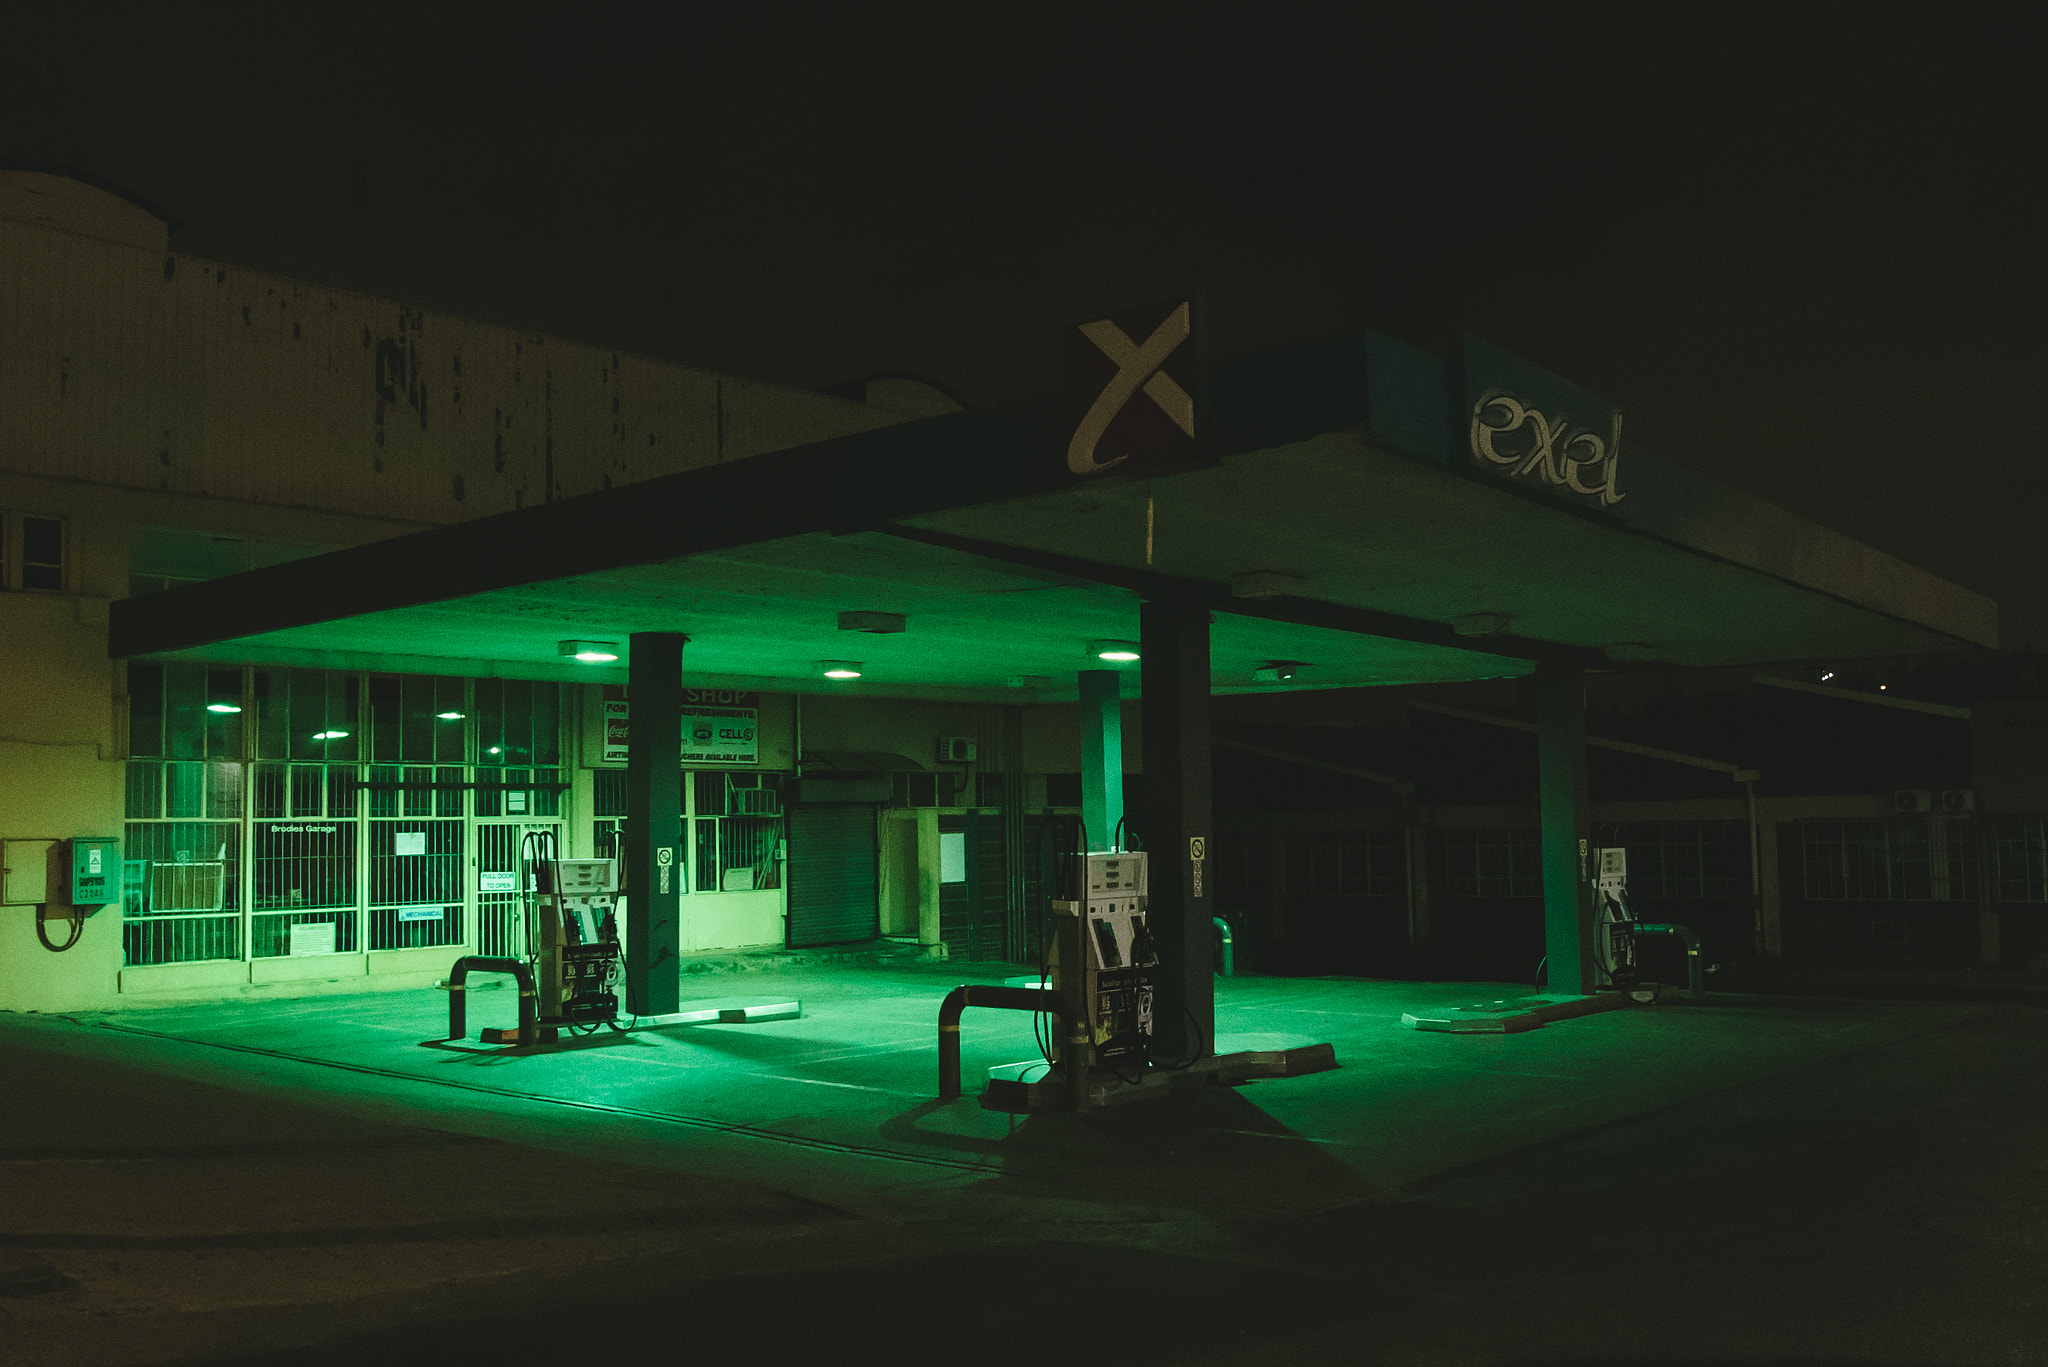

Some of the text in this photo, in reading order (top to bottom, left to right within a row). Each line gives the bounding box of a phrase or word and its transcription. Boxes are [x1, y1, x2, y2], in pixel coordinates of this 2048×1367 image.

[1472, 393, 1627, 508] exel
[686, 688, 746, 705] SHOP
[606, 703, 628, 713] FOR
[270, 824, 337, 834] Brodies Garage
